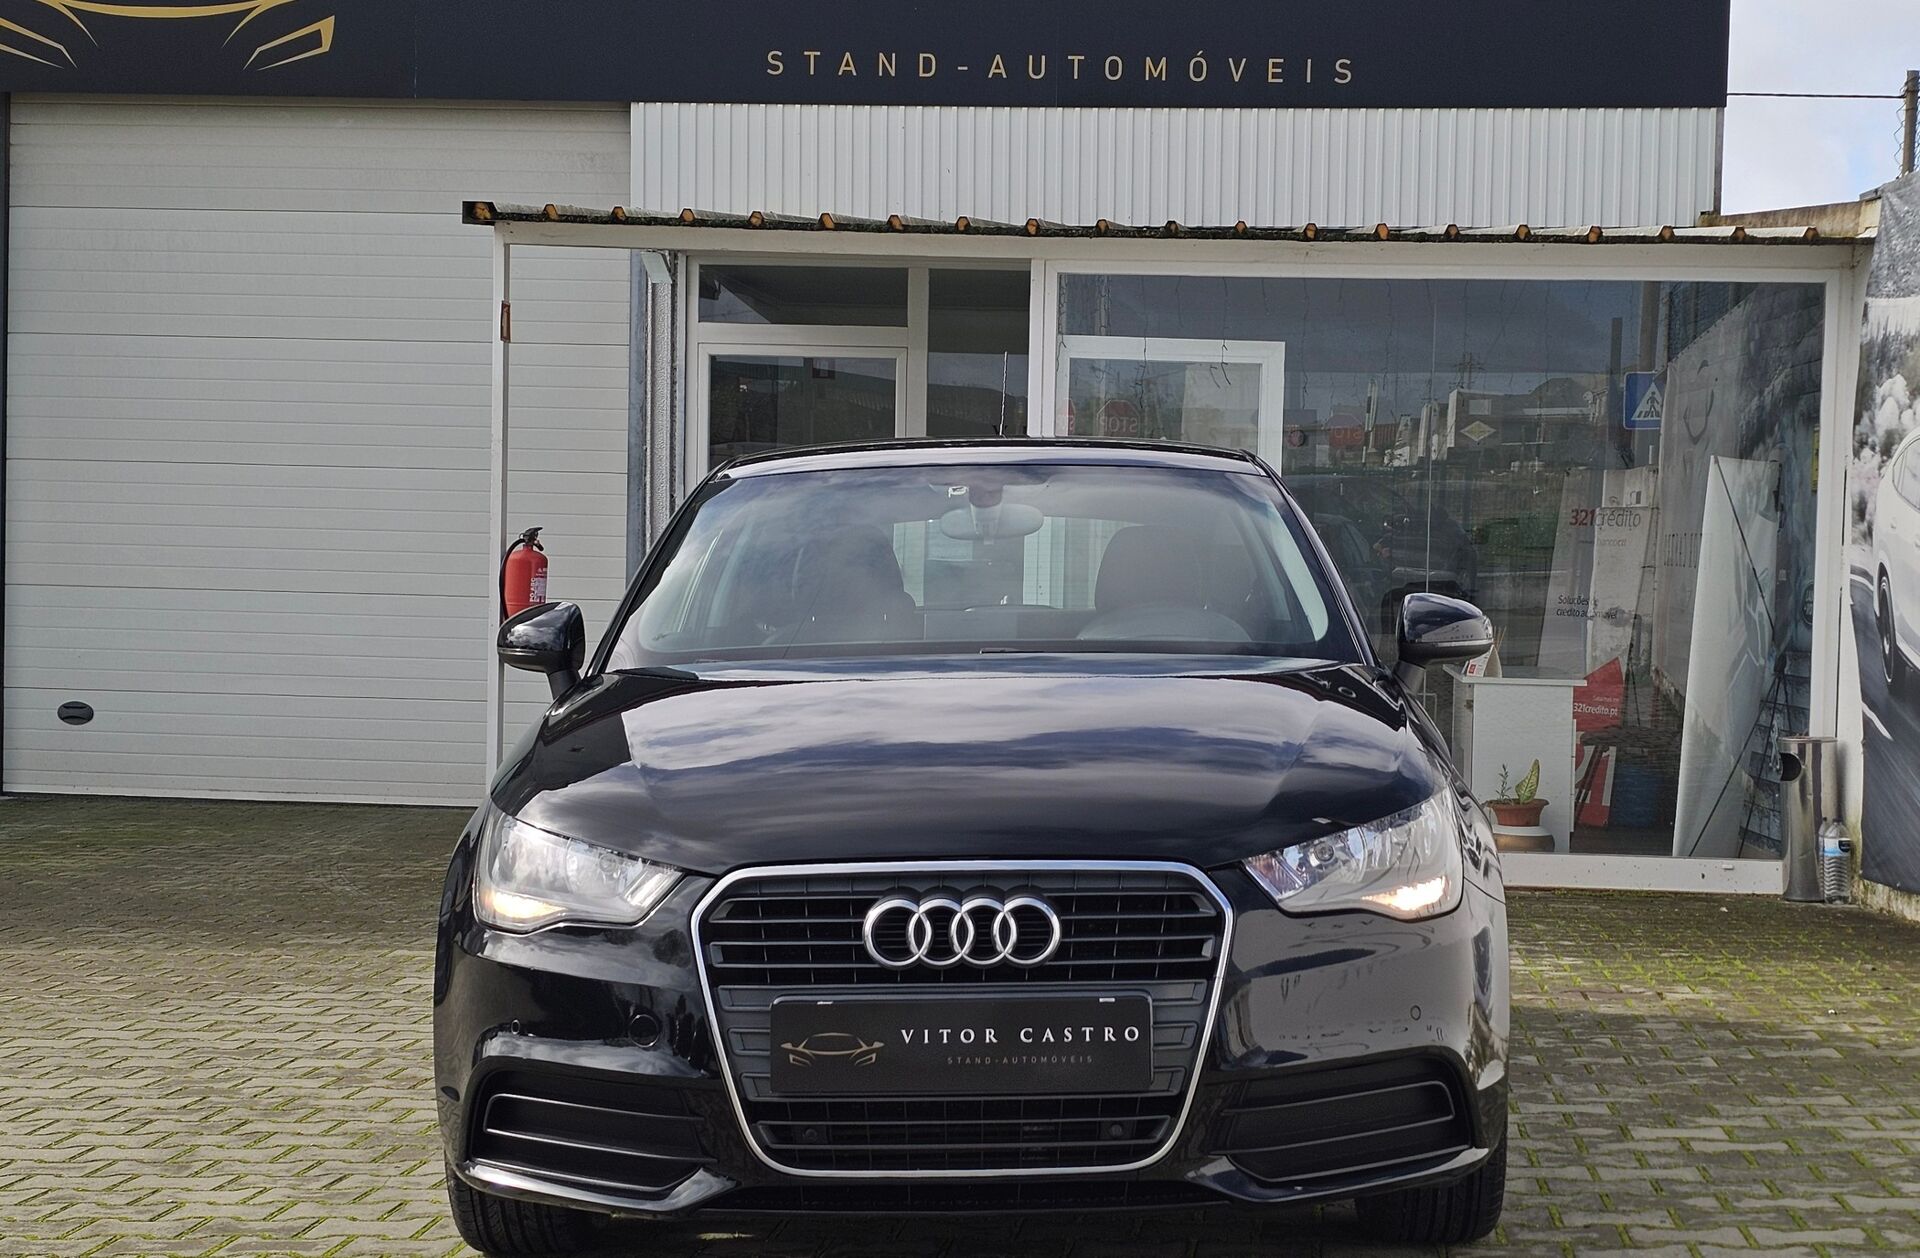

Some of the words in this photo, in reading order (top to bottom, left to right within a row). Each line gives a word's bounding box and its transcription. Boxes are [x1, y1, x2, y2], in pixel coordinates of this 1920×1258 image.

[766, 50, 1354, 85] STAND-AUTOMÓVEIS
[901, 1028, 999, 1045] VITOR
[1019, 1025, 1140, 1044] CASTRO
